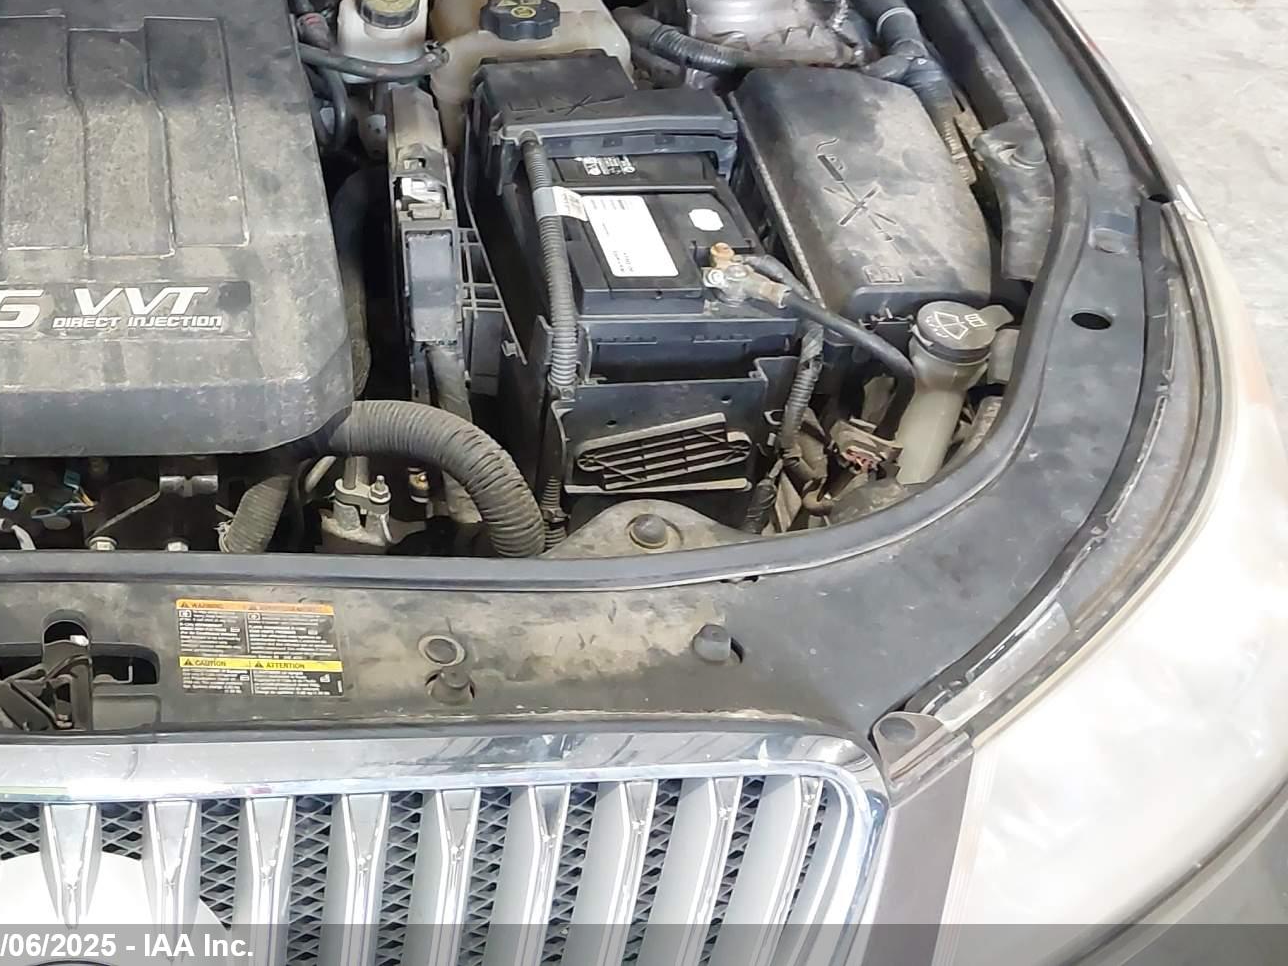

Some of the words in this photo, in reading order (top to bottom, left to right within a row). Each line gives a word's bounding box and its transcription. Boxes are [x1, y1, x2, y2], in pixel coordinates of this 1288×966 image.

[74, 287, 209, 315] VVT
[52, 316, 121, 328] DIRECT
[128, 316, 223, 328] INJECTION
[194, 659, 227, 667] CAUTION
[266, 662, 305, 670] ATTENTION
